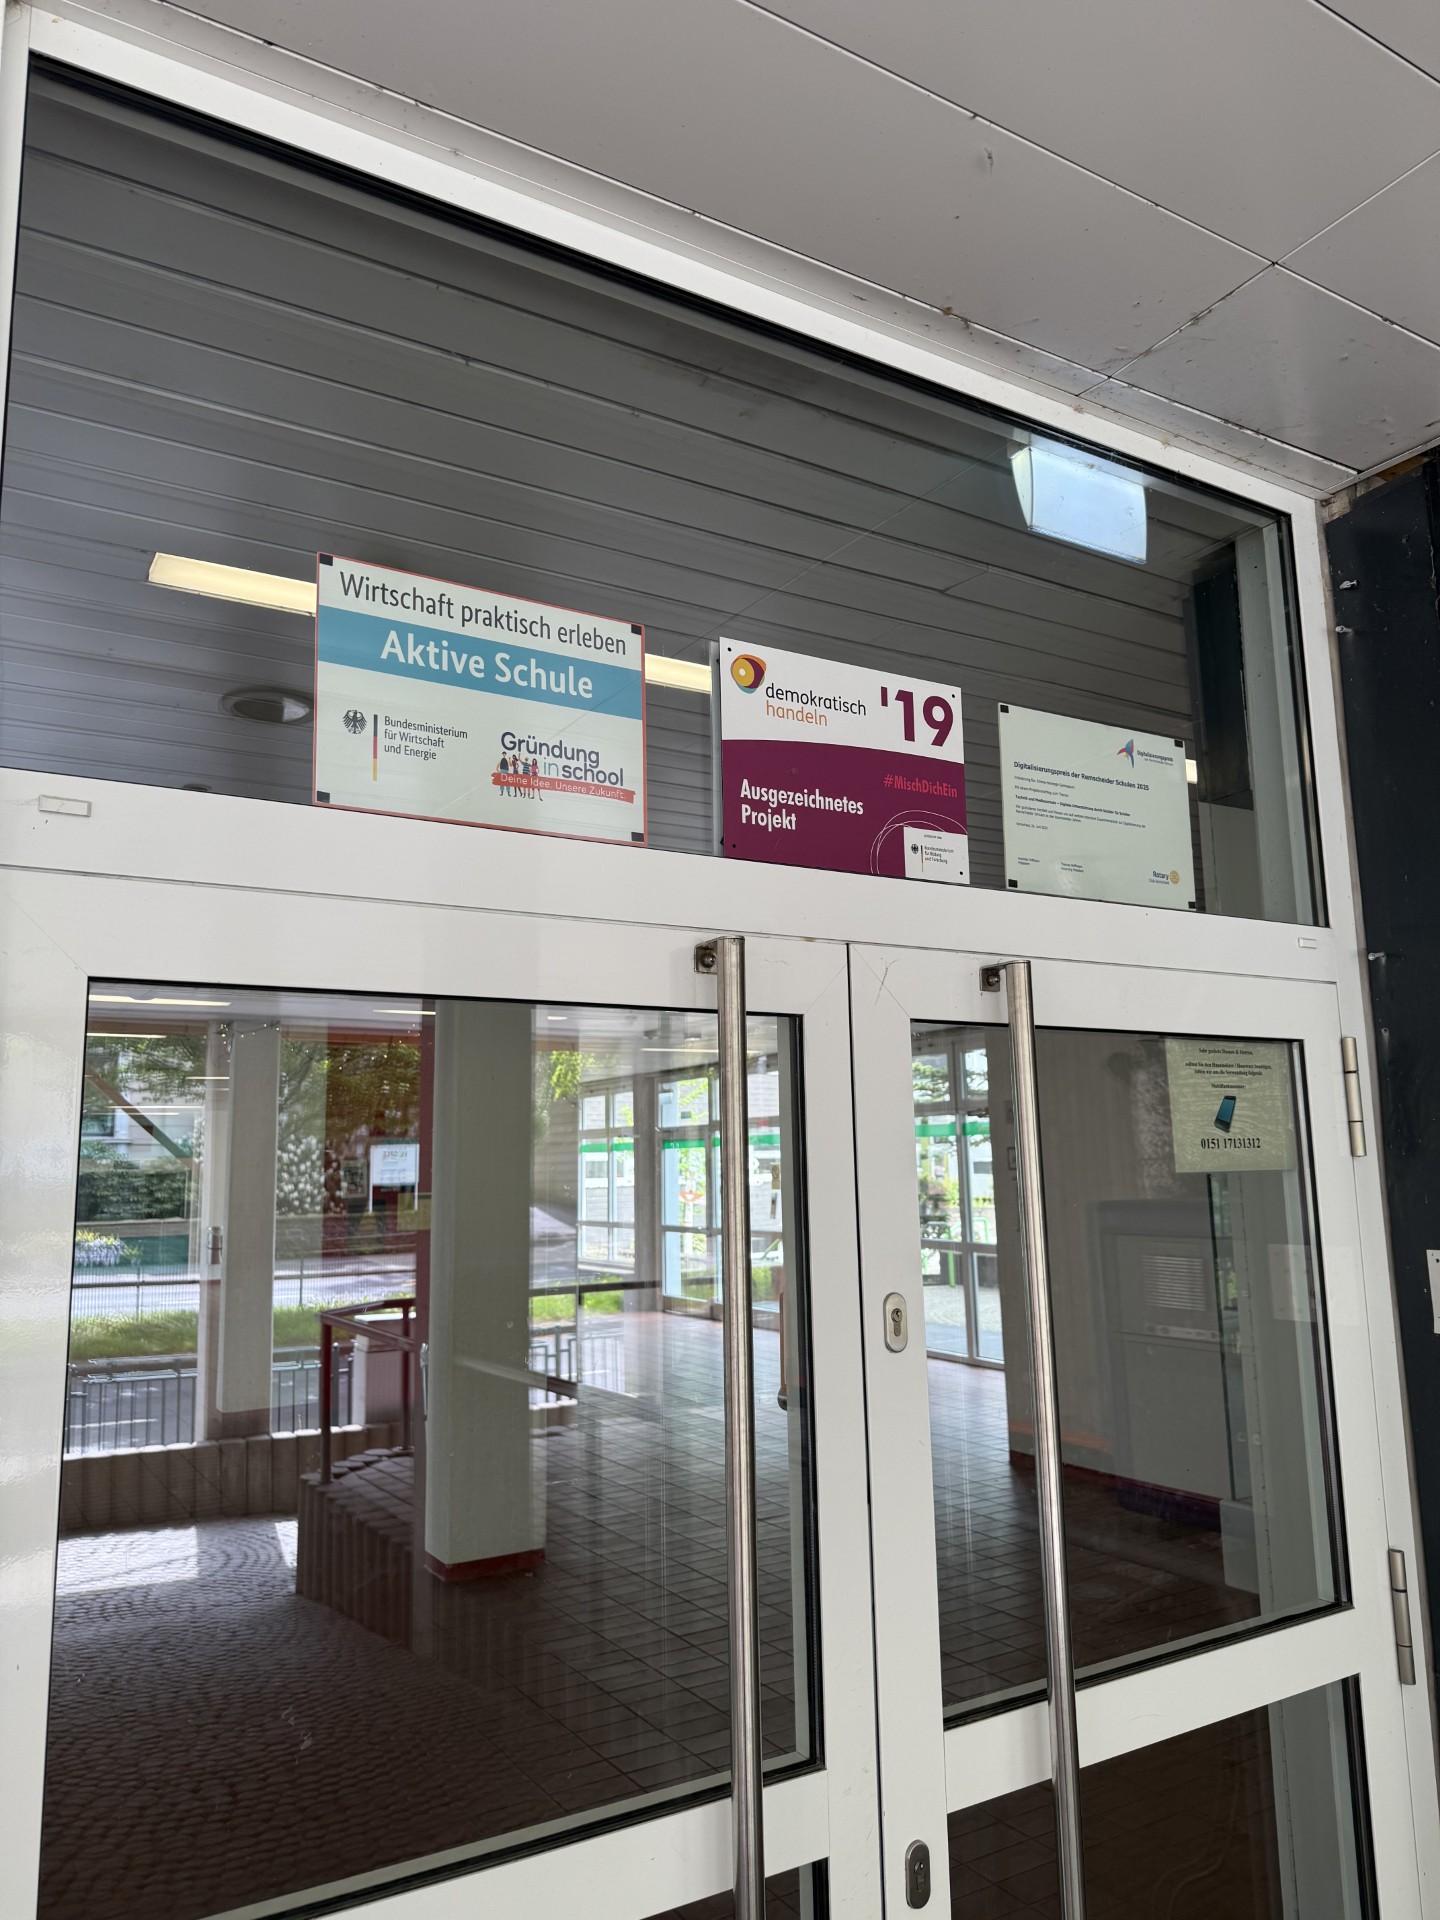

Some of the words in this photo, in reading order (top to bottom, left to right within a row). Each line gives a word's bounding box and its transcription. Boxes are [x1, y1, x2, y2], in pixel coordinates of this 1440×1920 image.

[340, 571, 454, 619] Wirtschaft
[461, 604, 550, 640] praktisch
[558, 624, 626, 655] erleben
[380, 630, 485, 678] Aktive
[495, 653, 593, 698] Schule
[765, 683, 867, 716] demokratisch
[384, 715, 467, 739] Bundesministerium
[766, 701, 828, 726] handeln
[880, 686, 954, 747] '19
[384, 729, 397, 740] für
[399, 731, 445, 748] Wirtschaft
[501, 731, 600, 768] Gründung
[384, 744, 401, 754] und
[404, 745, 436, 761] Energie
[501, 774, 528, 785] Deine
[555, 781, 587, 793] Unsere
[543, 757, 559, 777] in
[562, 762, 623, 786] school
[1013, 761, 1070, 776] Digitalisierungspreis
[1115, 779, 1136, 788] Schulen
[740, 778, 864, 815] Ausgezeichnetes
[883, 774, 958, 798] #MischDichEin
[741, 804, 797, 832] Projekt
[1152, 870, 1169, 881] Rotary
[1201, 1137, 1220, 1149] 0151
[1223, 1137, 1261, 1149] 17131312
